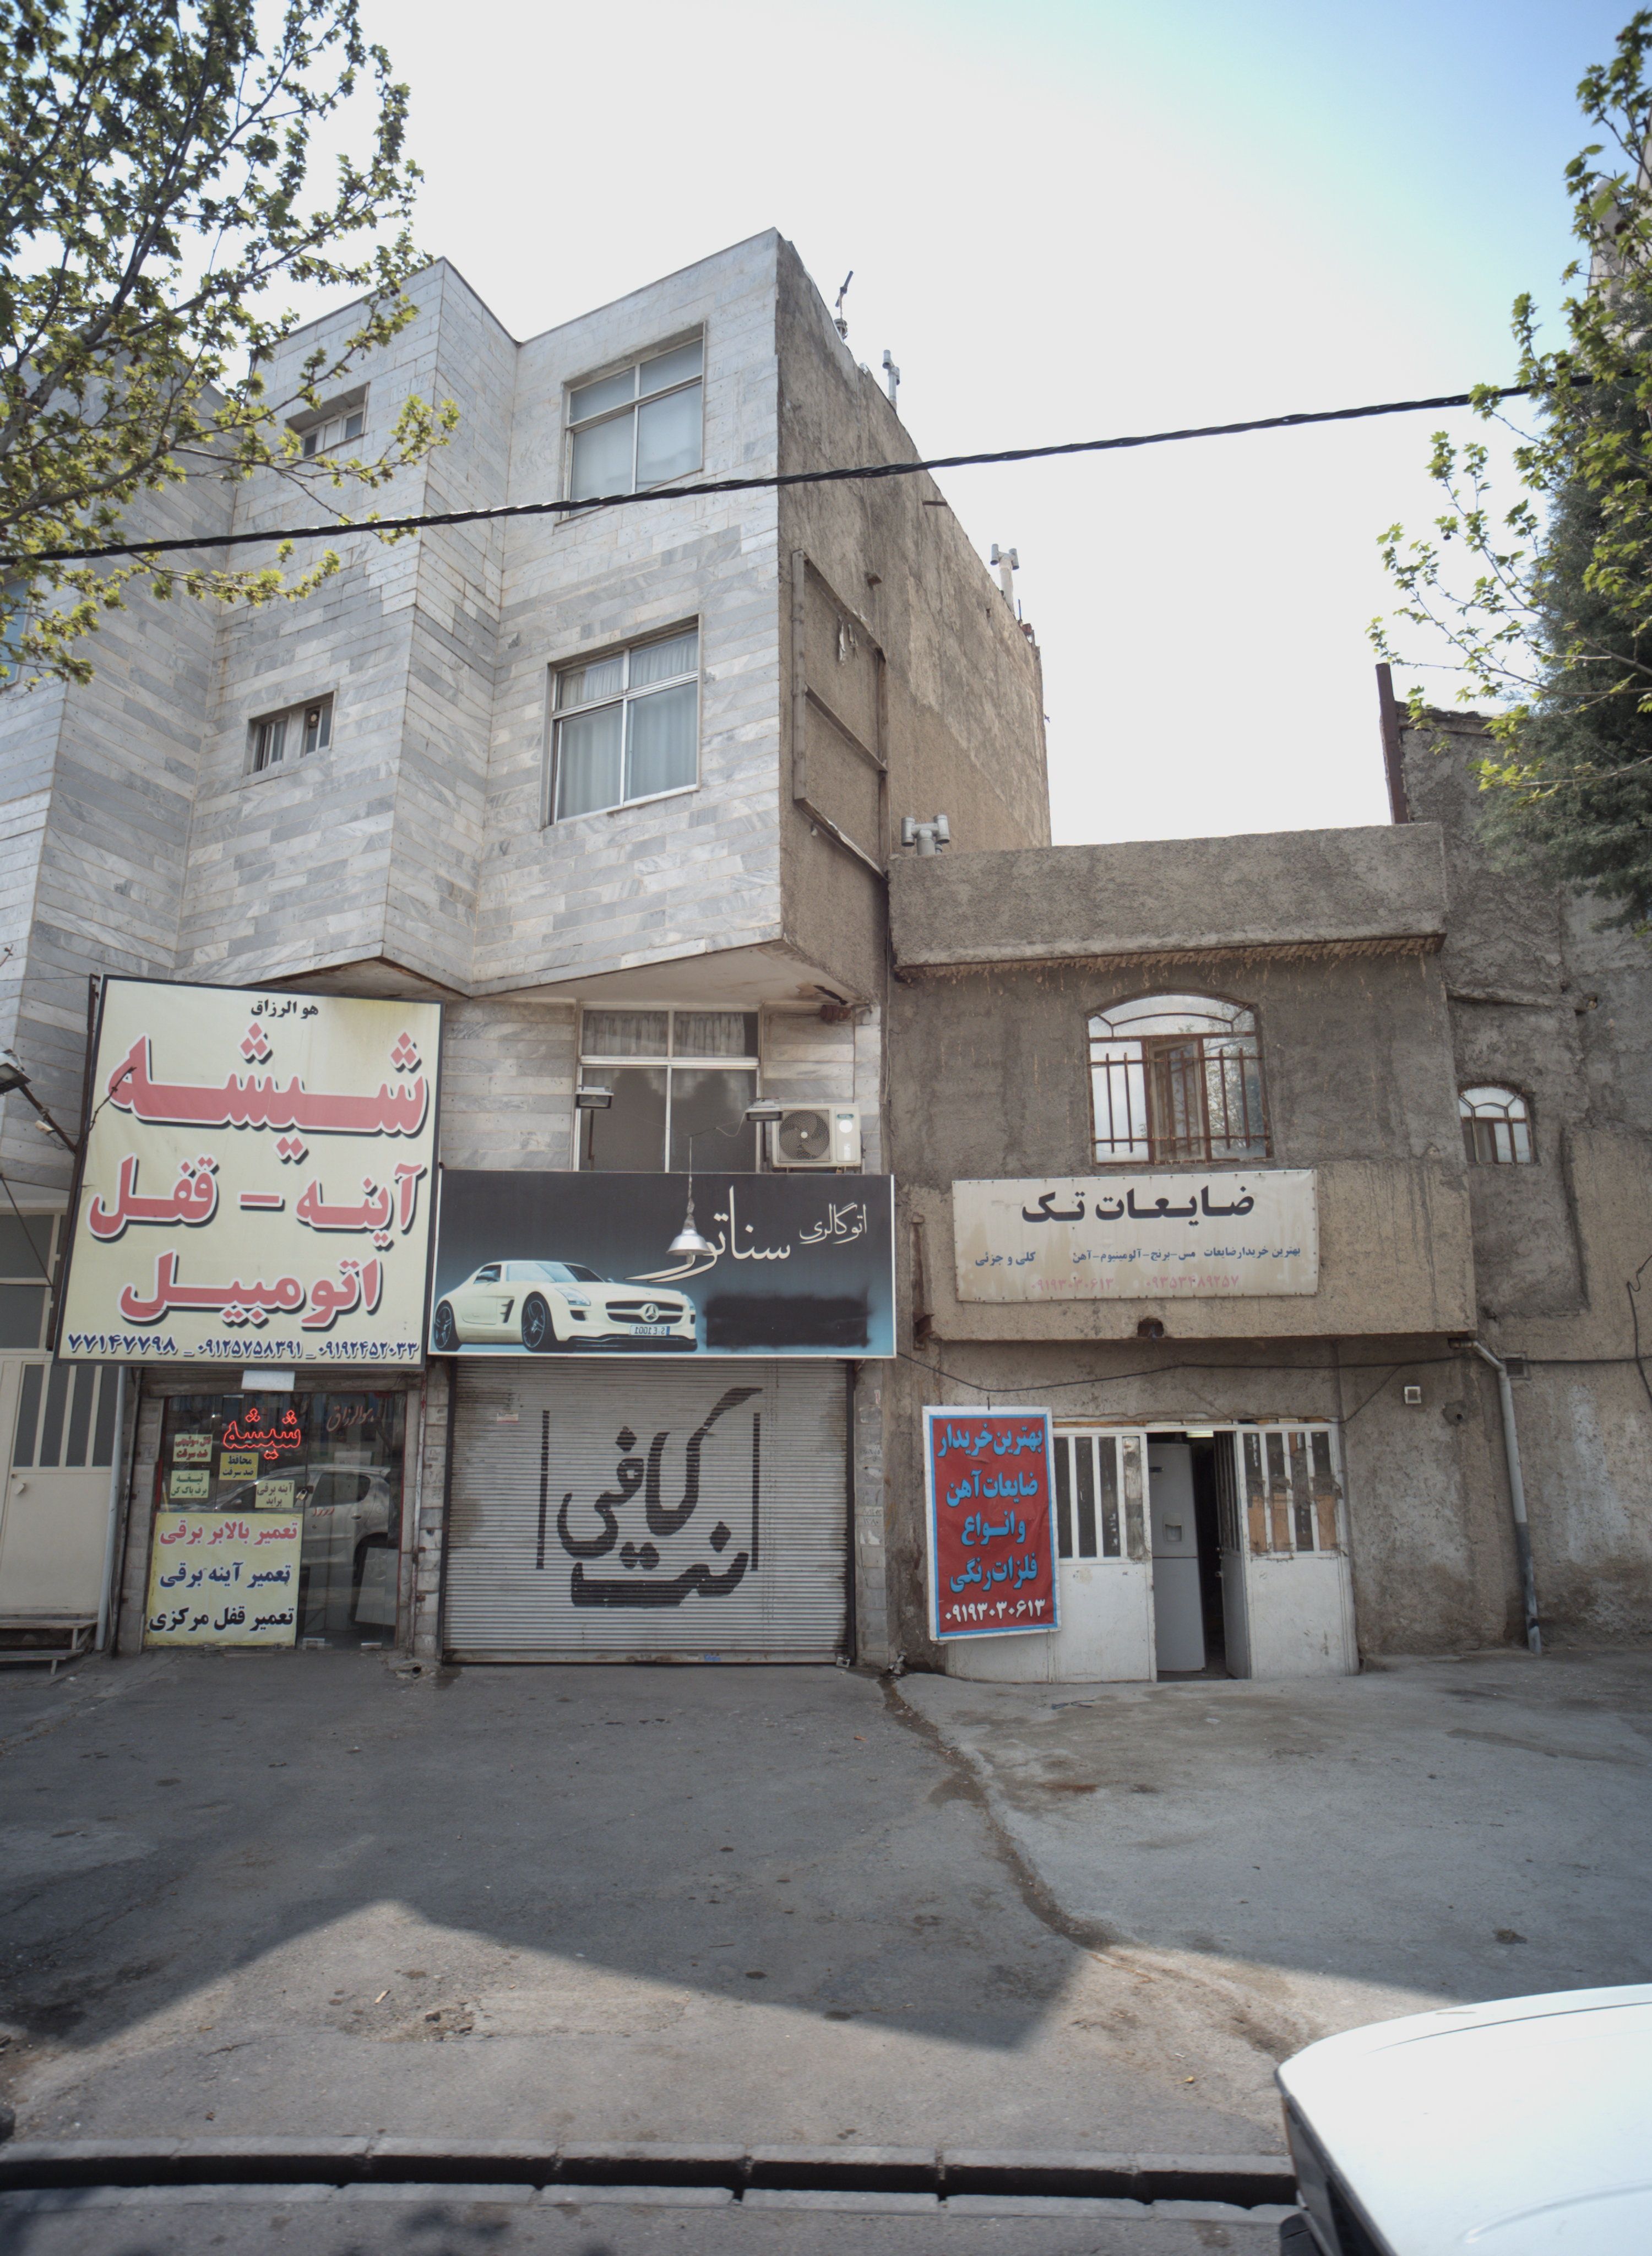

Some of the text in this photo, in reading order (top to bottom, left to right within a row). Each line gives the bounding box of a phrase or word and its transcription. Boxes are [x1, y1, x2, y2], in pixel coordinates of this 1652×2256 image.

[251, 999, 318, 1019] هو الرزاق
[108, 1023, 424, 1159] شیشه
[89, 1156, 214, 1234] قفل
[296, 1163, 422, 1244] آینه
[1021, 1185, 1254, 1226] ضایعات تک
[1007, 1256, 1013, 1266] و
[1015, 1251, 1036, 1266] کلی
[1271, 1246, 1301, 1259] بهترین
[120, 1252, 378, 1324] اتومبیل
[67, 1333, 176, 1352] ۷۷۱۴۷۷۹۸
[197, 1339, 301, 1357] ۰۹۱۲۵۷۵۸۳۹۱
[317, 1341, 418, 1357] ۰۹۱۹۲۴۵۲۰۳۳
[222, 1408, 301, 1459] شیشه
[937, 1423, 1043, 1457] بهترین خریدار
[228, 1455, 253, 1465] محافظ
[222, 1468, 242, 1478] سرقت
[257, 1482, 294, 1496] آینه برقی
[557, 1387, 763, 1608] کافی نت
[946, 1469, 1039, 1507] ضایعات آهن
[160, 1520, 298, 1545] تعمیر بالابر برقی
[160, 1562, 291, 1588] تعمیر آینه برقی
[949, 1553, 1038, 1593] فلزات رنگی
[149, 1605, 295, 1631] تعمیر قفل مرکزی
[945, 1599, 1046, 1623] ۰۹۱۹۳۰۳۰۶۱۳
